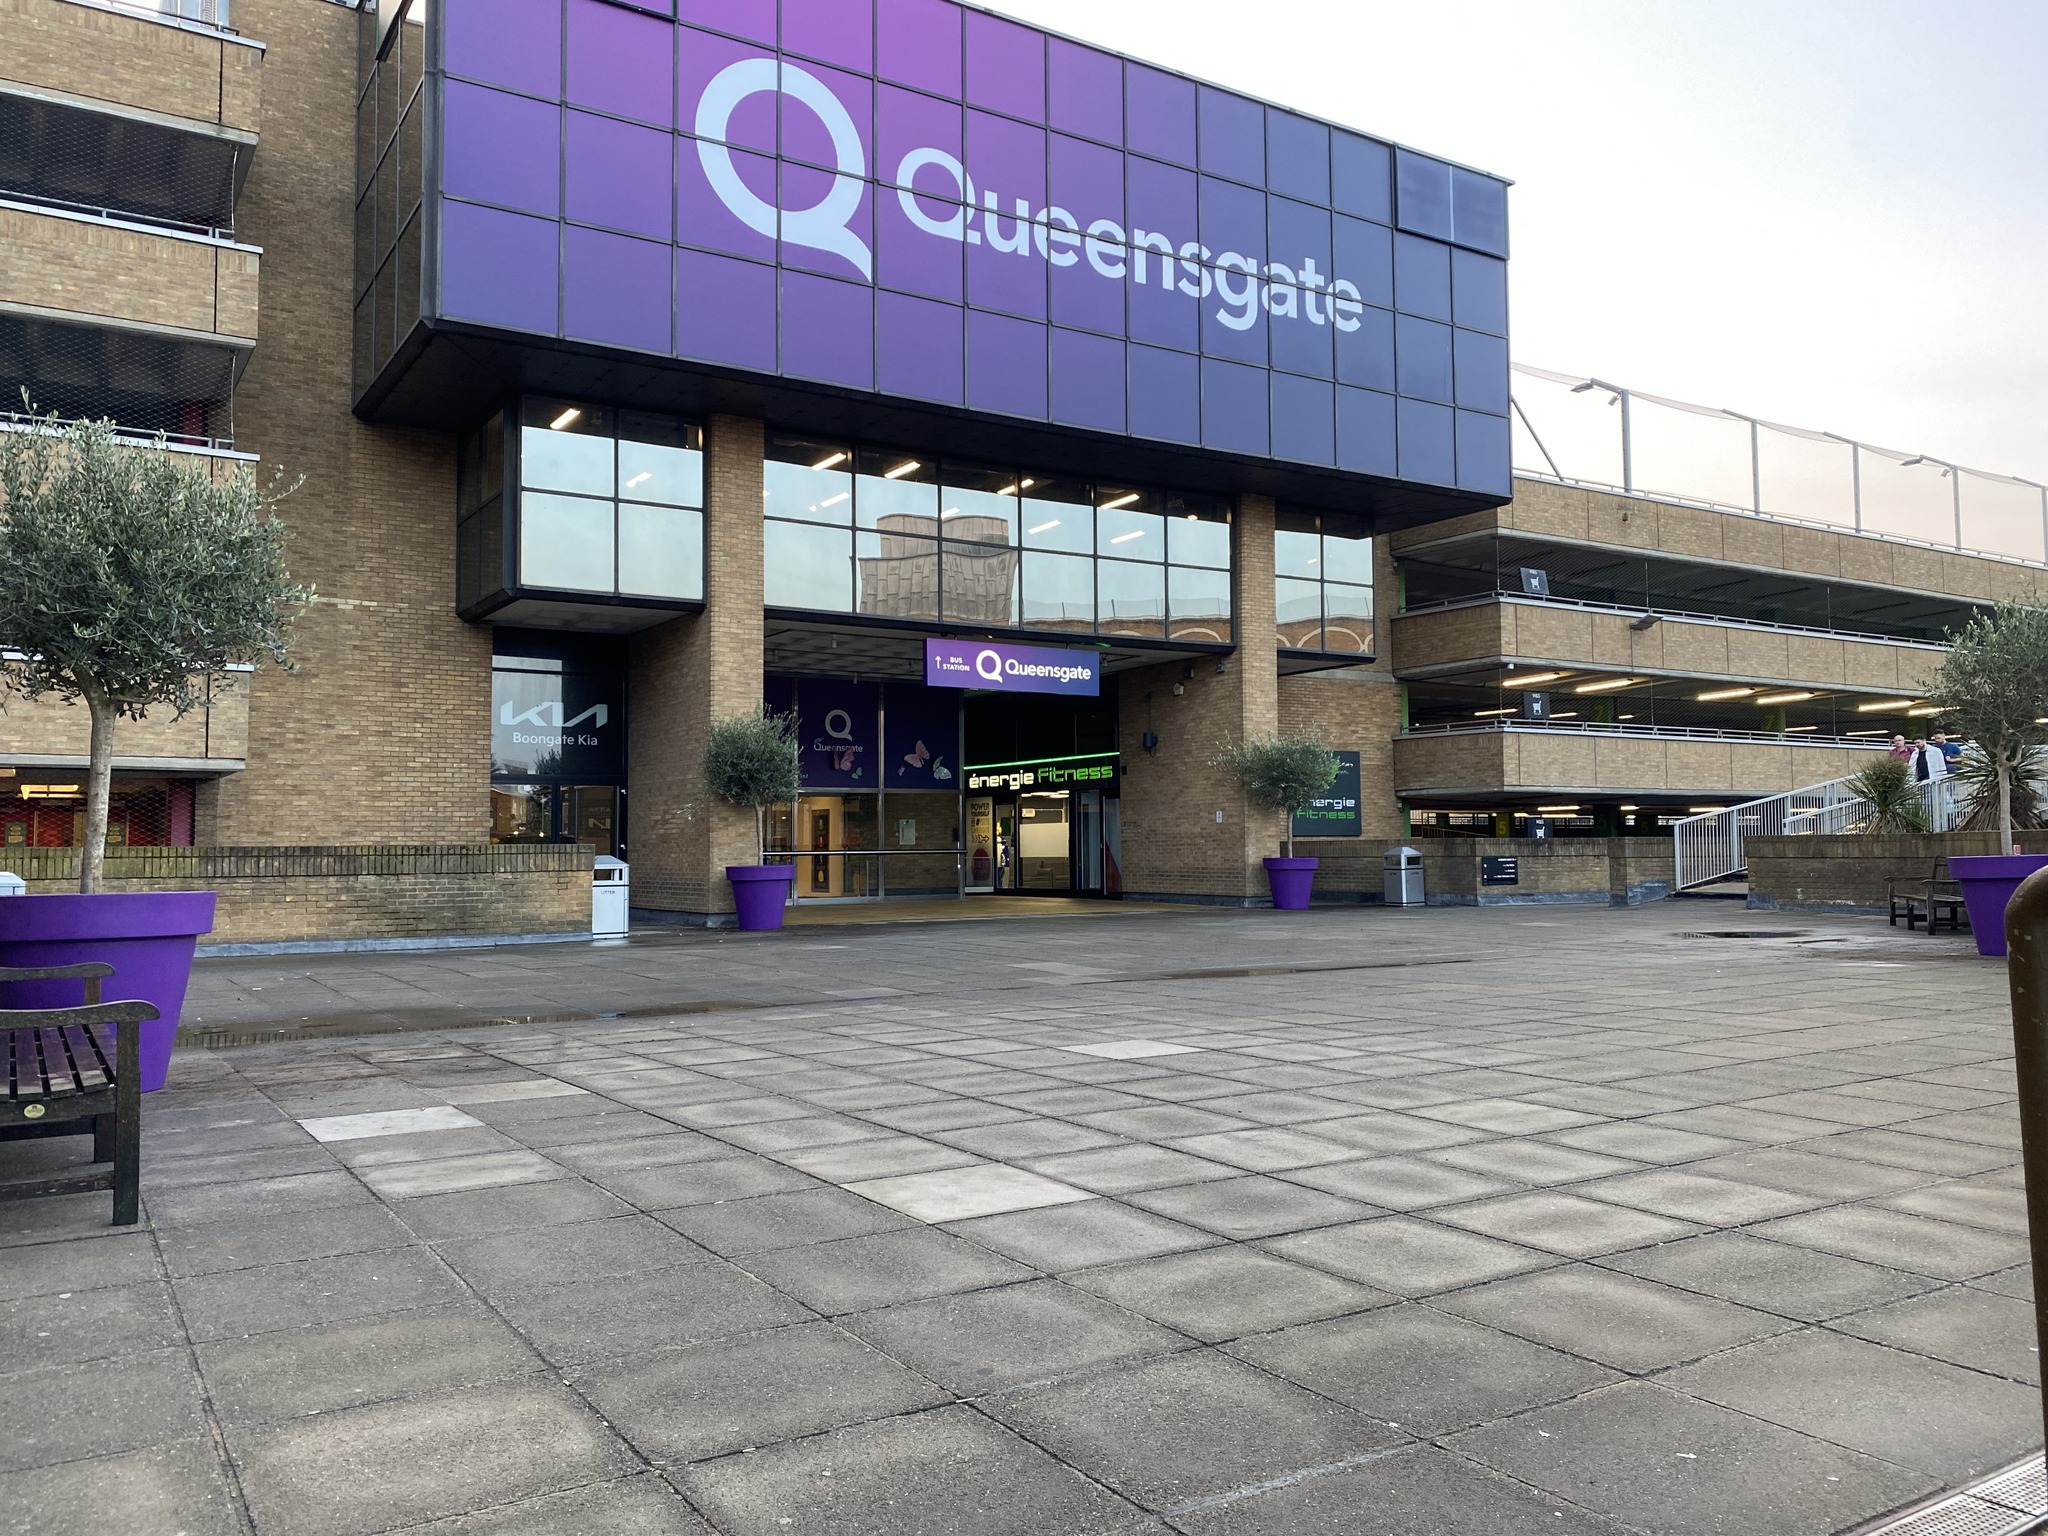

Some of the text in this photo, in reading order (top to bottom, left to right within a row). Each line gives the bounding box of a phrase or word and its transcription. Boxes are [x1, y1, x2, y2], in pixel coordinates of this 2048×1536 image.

[896, 147, 1363, 332] Queensgate
[942, 663, 970, 672] STATION
[1005, 658, 1092, 682] Queensgate
[512, 732, 598, 747] Boongate Kia
[969, 769, 1035, 790] énergie
[971, 803, 990, 811] POWER
[1309, 797, 1355, 809] nergie
[1498, 821, 1506, 834] 5
